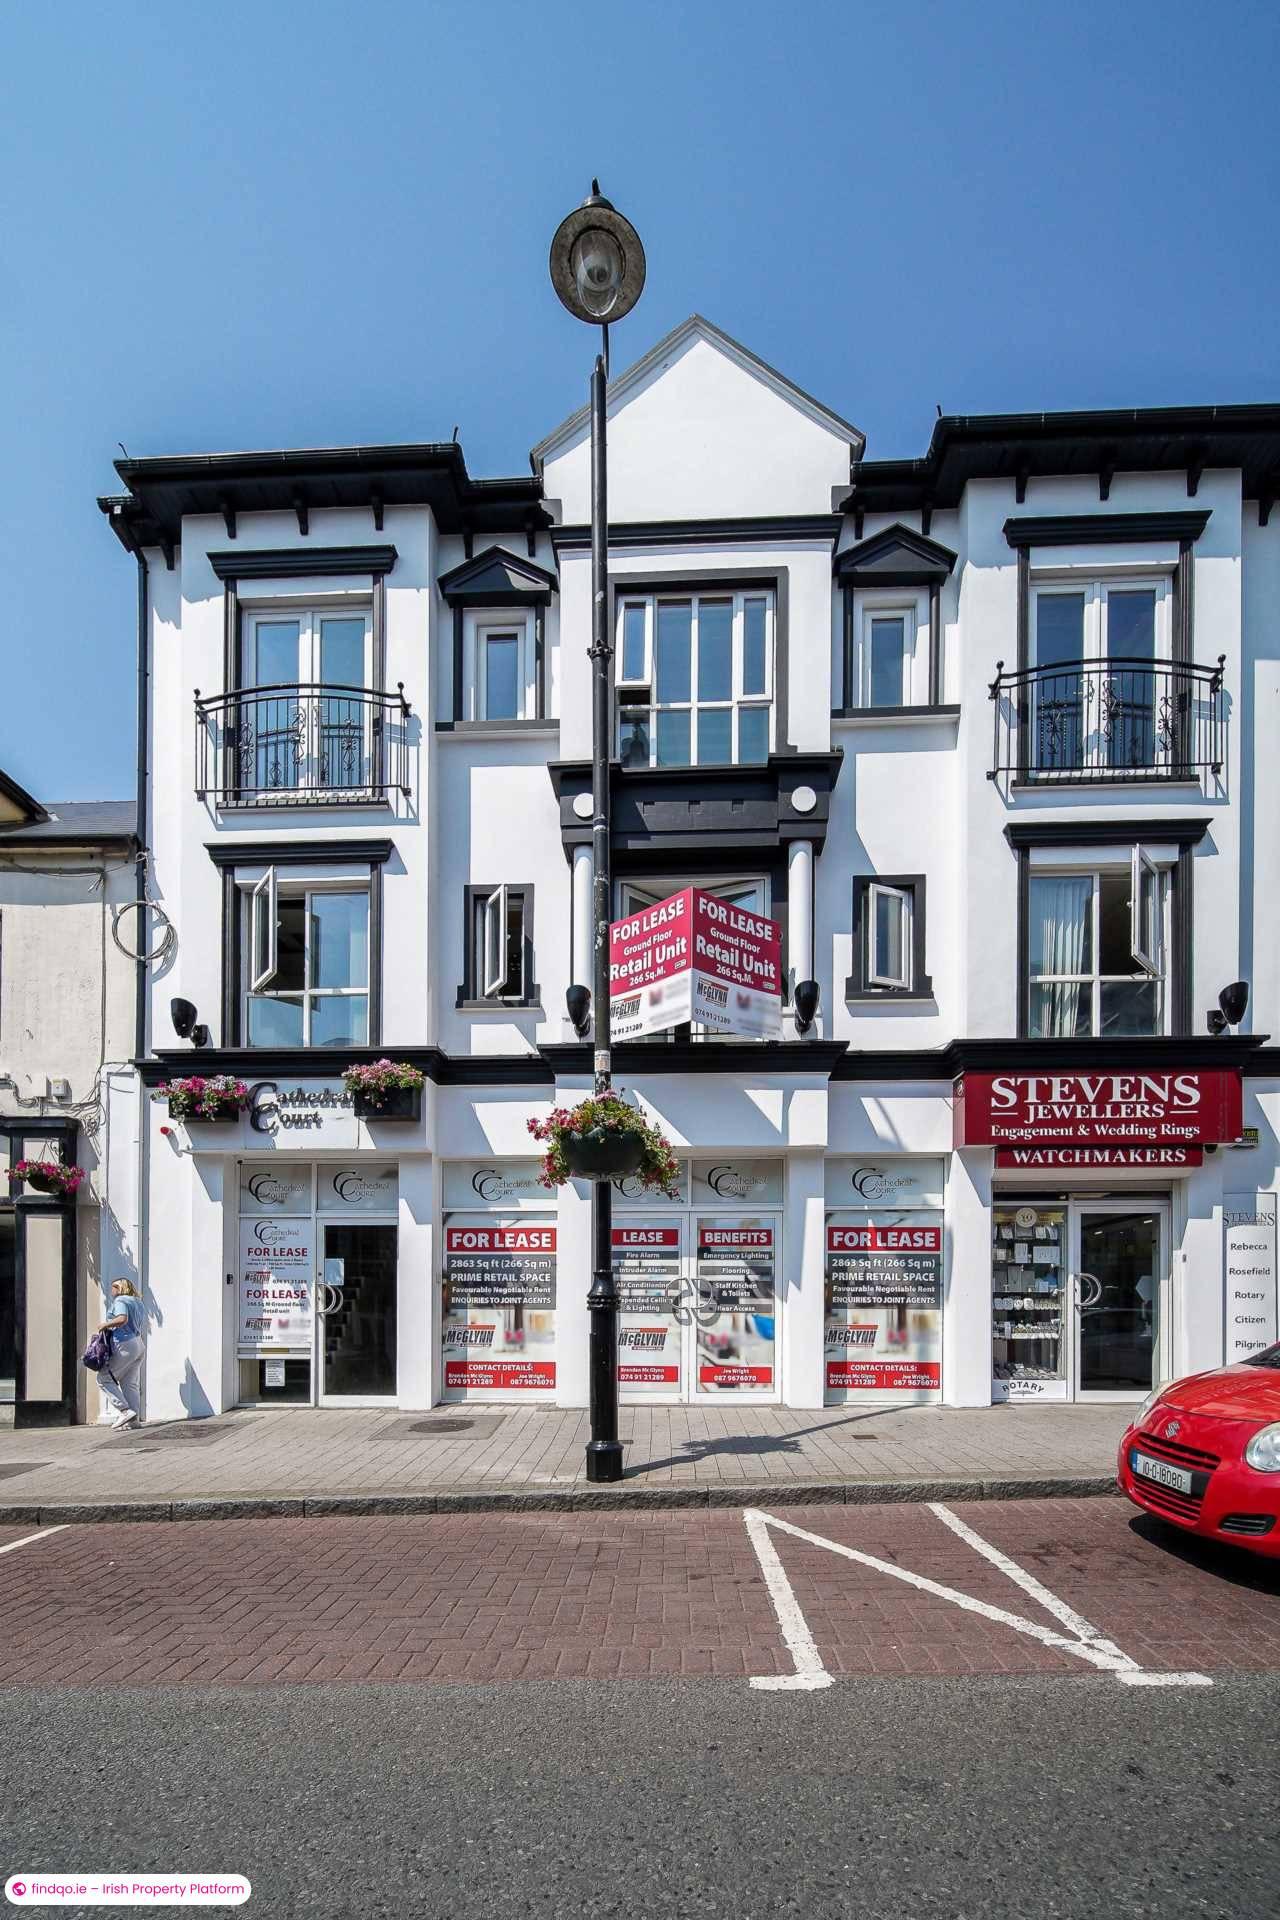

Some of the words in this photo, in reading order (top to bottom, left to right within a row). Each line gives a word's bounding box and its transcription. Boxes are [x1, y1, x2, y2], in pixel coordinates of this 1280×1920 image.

[612, 920, 640, 944] FOR
[643, 898, 684, 932] LEASE
[699, 897, 727, 925] FOR
[730, 911, 772, 941] LEASE
[624, 937, 652, 956] Ground
[653, 930, 672, 945] Floor
[710, 927, 739, 946] Ground
[740, 939, 760, 953] Floor
[610, 950, 652, 981] Retail
[655, 936, 687, 964] Unit
[696, 934, 739, 967] Retail
[743, 953, 775, 979] Unit
[716, 964, 731, 977] 266
[629, 976, 644, 986] 266
[697, 982, 729, 1003] McGLYNN
[991, 1075, 1201, 1108] STEVENS
[250, 1103, 323, 1132] Court
[1024, 1103, 1164, 1124] JEWELLERS
[991, 1124, 1073, 1140] Engagement
[1077, 1125, 1090, 1136] &
[1094, 1124, 1157, 1139] Wedding
[1161, 1123, 1200, 1138] Rings
[1012, 1149, 1186, 1164] WATCHMAKERS
[1222, 1212, 1274, 1226] STEVENS
[452, 1232, 490, 1248] FOR
[494, 1232, 552, 1248] LEASE
[622, 1232, 664, 1243] LEASE
[704, 1232, 768, 1243] BENEFITS
[833, 1231, 872, 1247] FOR
[876, 1231, 936, 1247] LEASE
[247, 1247, 270, 1257] FOR
[273, 1247, 308, 1257] LEASE
[1230, 1242, 1268, 1250] Rebecca
[704, 1252, 740, 1260] Emergency
[741, 1252, 769, 1260] Lighting
[450, 1259, 475, 1267] 2863
[476, 1259, 489, 1269] Sq
[491, 1259, 499, 1267] ft
[501, 1259, 522, 1268] (266
[524, 1259, 537, 1269] Sq
[538, 1259, 551, 1268] m)
[832, 1259, 857, 1267] 2863
[858, 1259, 871, 1269] Sq
[873, 1259, 882, 1267] ft
[883, 1259, 906, 1268] (266
[907, 1259, 921, 1269] Sq
[922, 1259, 935, 1268] m)
[450, 1273, 482, 1281] PRIME
[484, 1273, 518, 1281] RETAIL
[519, 1273, 551, 1281] SPACE
[832, 1273, 865, 1281] PRIME
[866, 1273, 901, 1281] RETAIL
[902, 1273, 935, 1281] SPACE
[1229, 1267, 1271, 1276] Rosefield
[247, 1290, 269, 1299] FOR
[272, 1290, 307, 1299] LEASE
[493, 1286, 532, 1294] Negotiable
[875, 1286, 916, 1294] Negotiable
[1234, 1291, 1265, 1300] Rotary
[832, 1296, 871, 1304] ENQUIRIES
[872, 1296, 882, 1304] TO
[883, 1296, 905, 1304] JOINT
[906, 1296, 936, 1304] AGENTS
[1235, 1315, 1266, 1324] Citizen
[447, 1330, 494, 1343] McGLYNN
[618, 1334, 666, 1346] McGLYNN
[827, 1330, 877, 1344] McGLYNN
[1235, 1340, 1267, 1350] Pilgrim
[1002, 1381, 1044, 1393] ROTARY
